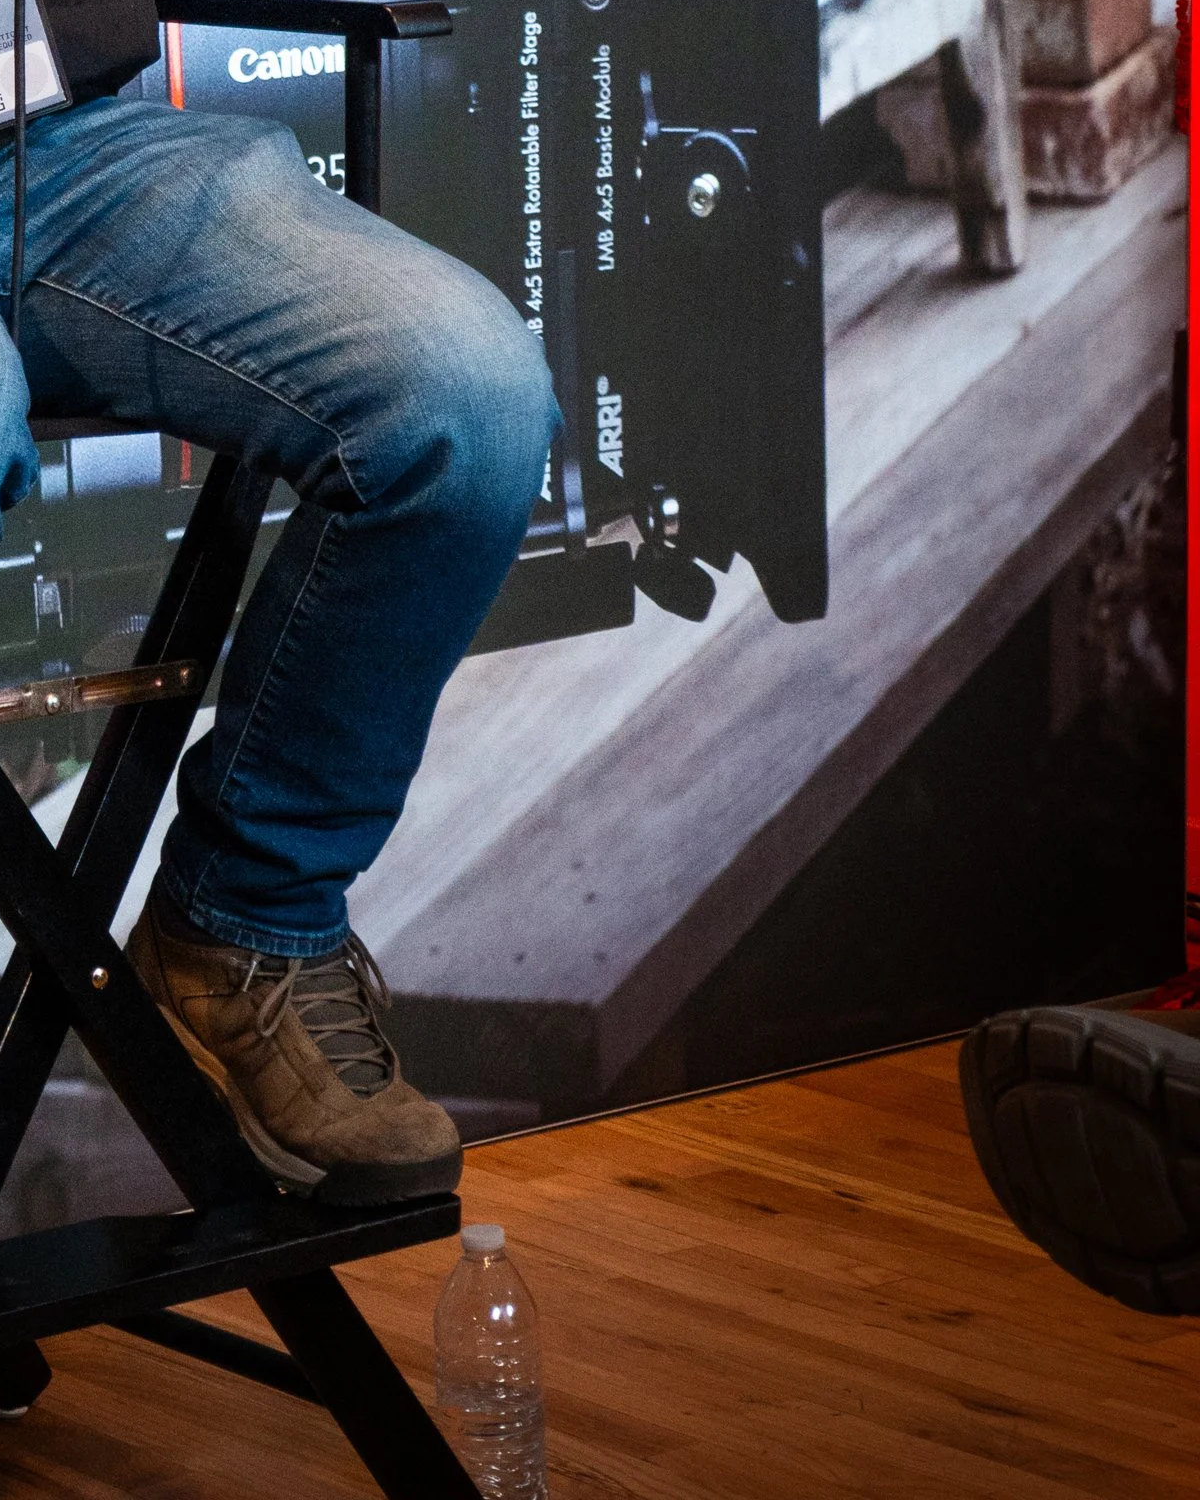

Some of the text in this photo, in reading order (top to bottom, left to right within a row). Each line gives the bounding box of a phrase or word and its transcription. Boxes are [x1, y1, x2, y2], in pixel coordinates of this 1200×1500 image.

[0, 25, 29, 41] TICT
[519, 11, 542, 67] Stage
[228, 43, 346, 83] Canon
[519, 71, 540, 120] Filter
[520, 124, 542, 215] Rotatable
[591, 43, 616, 272] LMB 4x5 Basic Module
[524, 219, 543, 270] Extra
[524, 274, 544, 313] 4x5
